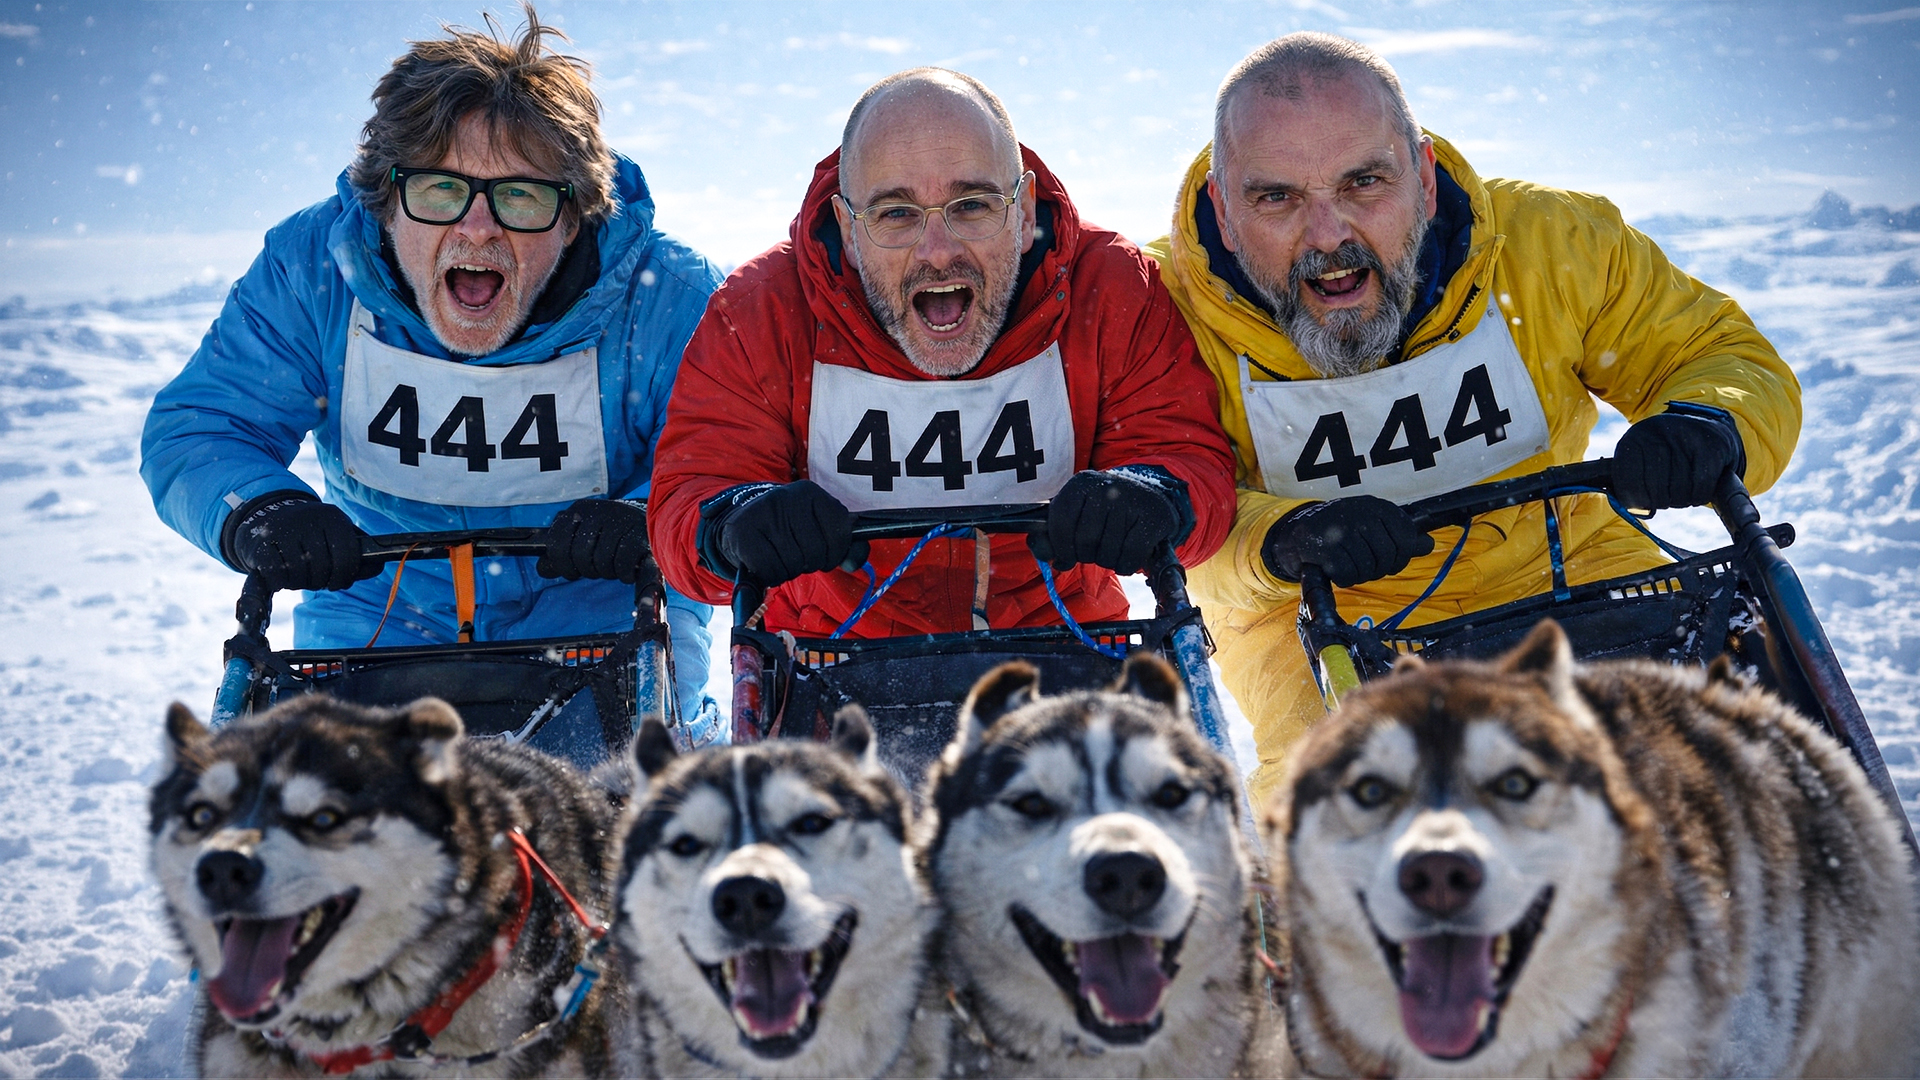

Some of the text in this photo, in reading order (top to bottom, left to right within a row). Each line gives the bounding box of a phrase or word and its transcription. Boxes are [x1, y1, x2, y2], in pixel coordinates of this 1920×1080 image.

[368, 384, 568, 472] 444
[837, 400, 1044, 491] 444
[1294, 364, 1511, 488] 444
